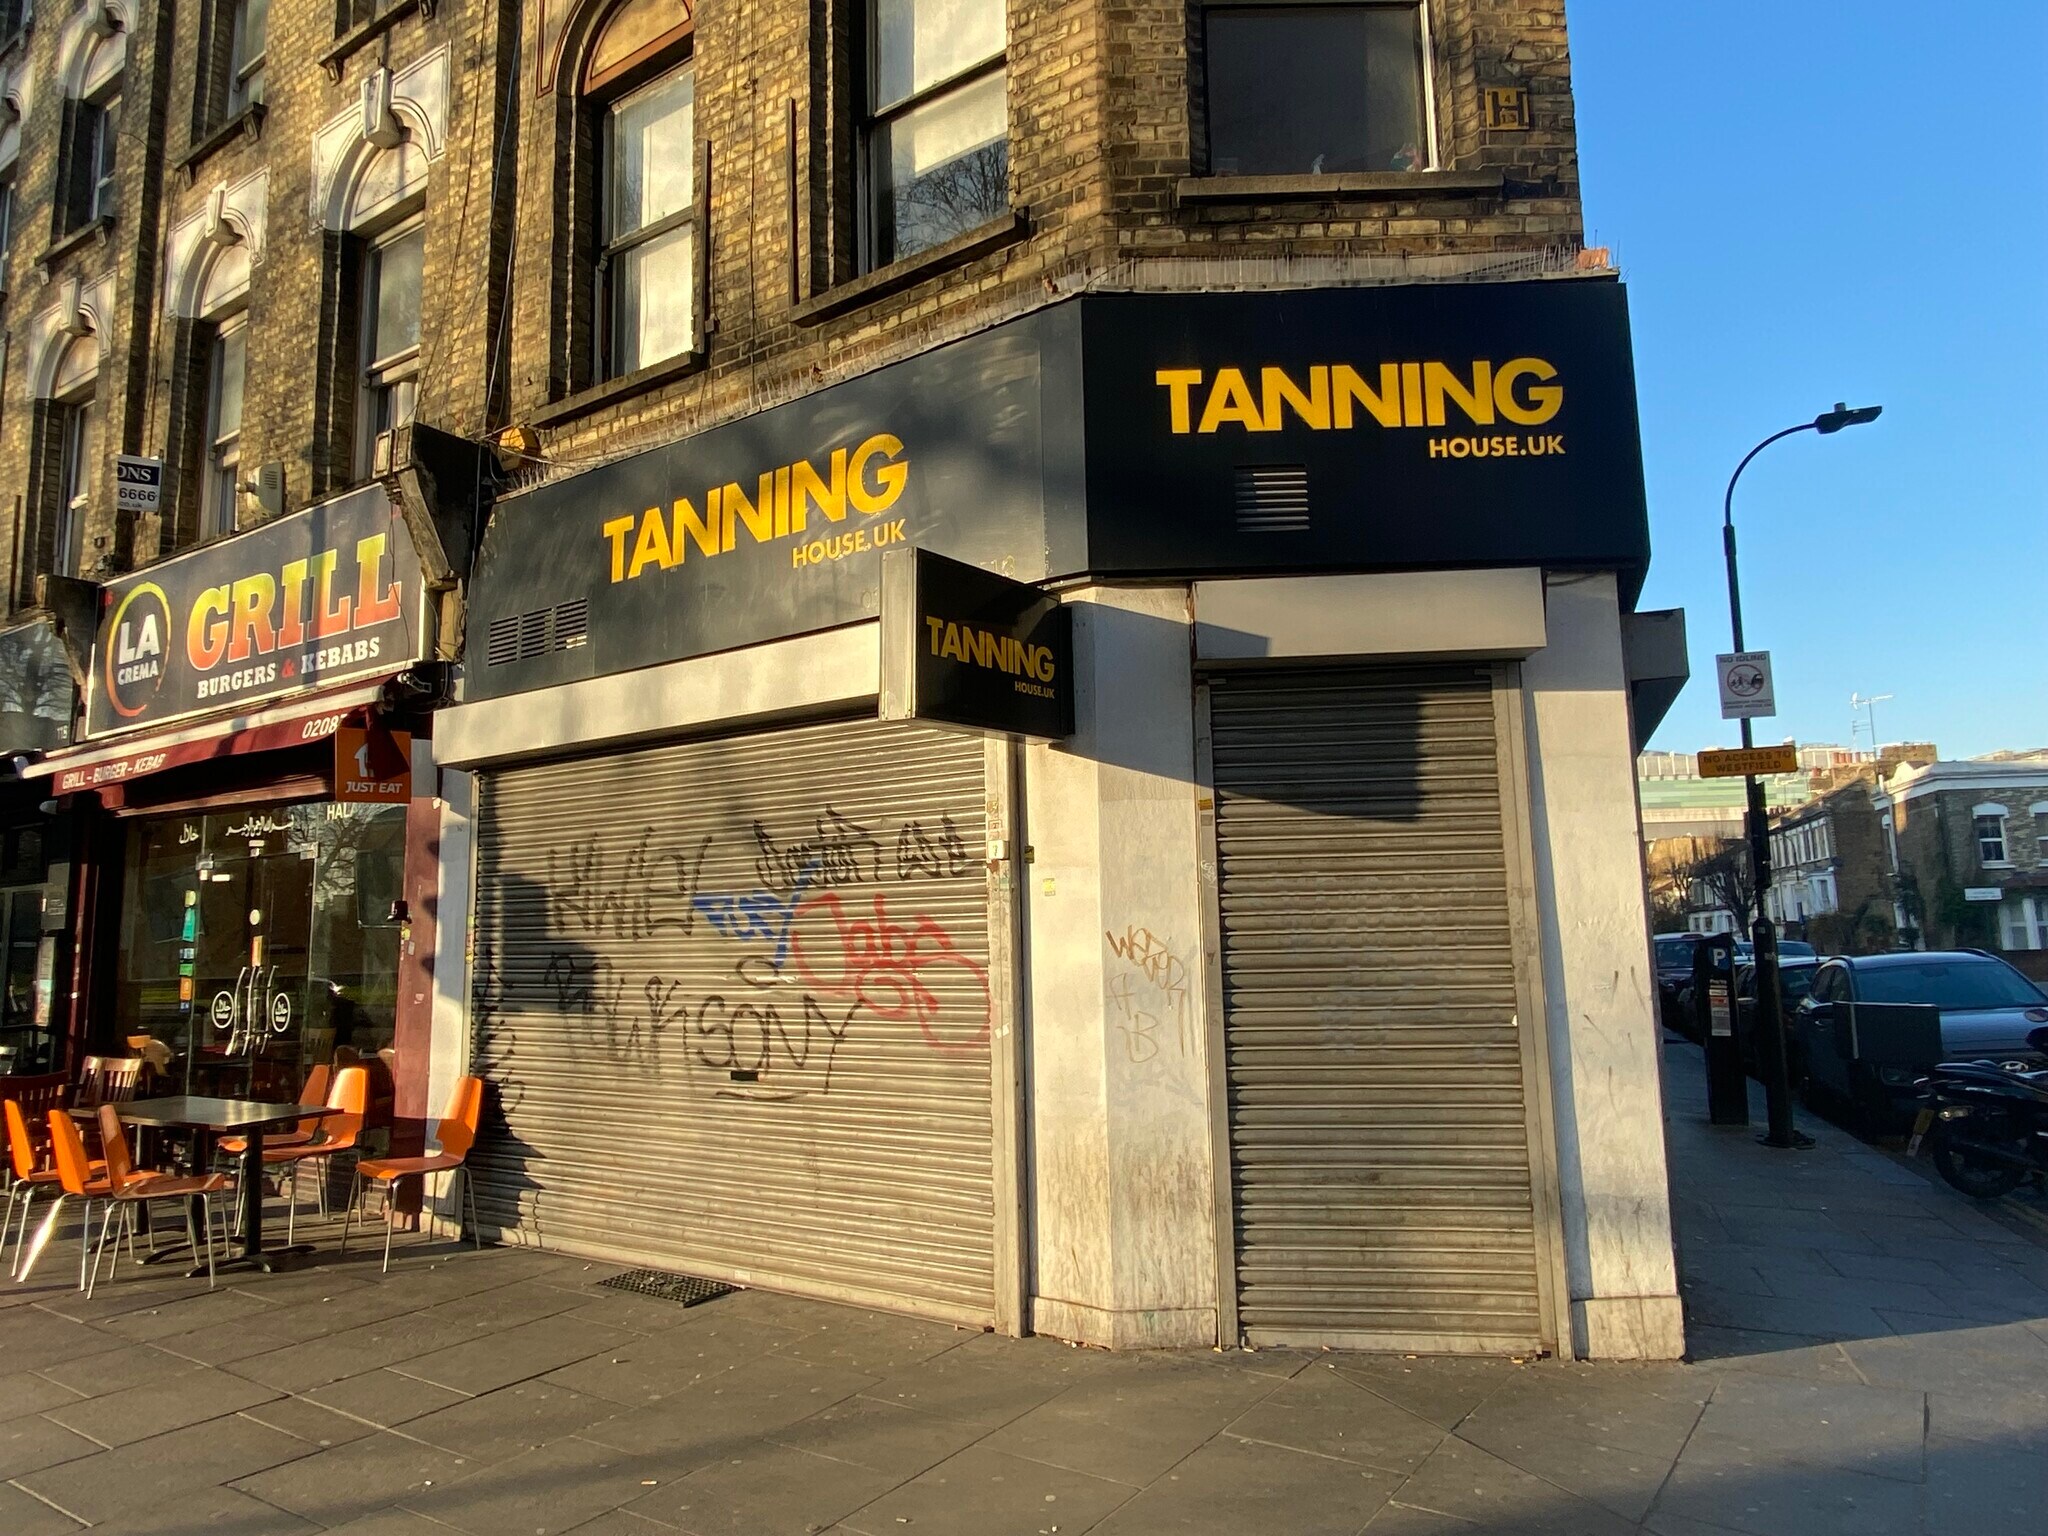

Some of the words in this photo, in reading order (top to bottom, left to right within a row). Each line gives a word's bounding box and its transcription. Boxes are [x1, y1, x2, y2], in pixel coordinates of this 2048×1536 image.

[1155, 357, 1564, 434] TANNING
[1428, 435, 1566, 459] HOUSE.UK
[119, 487, 156, 502] 6666
[602, 432, 910, 584] TANNING
[792, 517, 907, 569] HOUSE.UK
[186, 532, 402, 672] GRILL
[118, 613, 161, 665] LA
[926, 615, 1055, 683] TANNING
[117, 660, 159, 686] CREMA
[197, 662, 276, 699] BURGERS
[281, 658, 295, 678] &
[301, 636, 380, 674] KEBABS
[1014, 681, 1055, 699] HOUSE.UK
[1704, 755, 1720, 764] NO
[1725, 751, 1772, 762] ACCESS
[1775, 750, 1791, 759] TO
[1716, 761, 1781, 772] WESTFIELD
[62, 770, 86, 790] GRILL
[93, 761, 129, 783] BURGER
[345, 781, 377, 794] JUST
[379, 783, 403, 794] EAT
[1713, 948, 1726, 967] P
